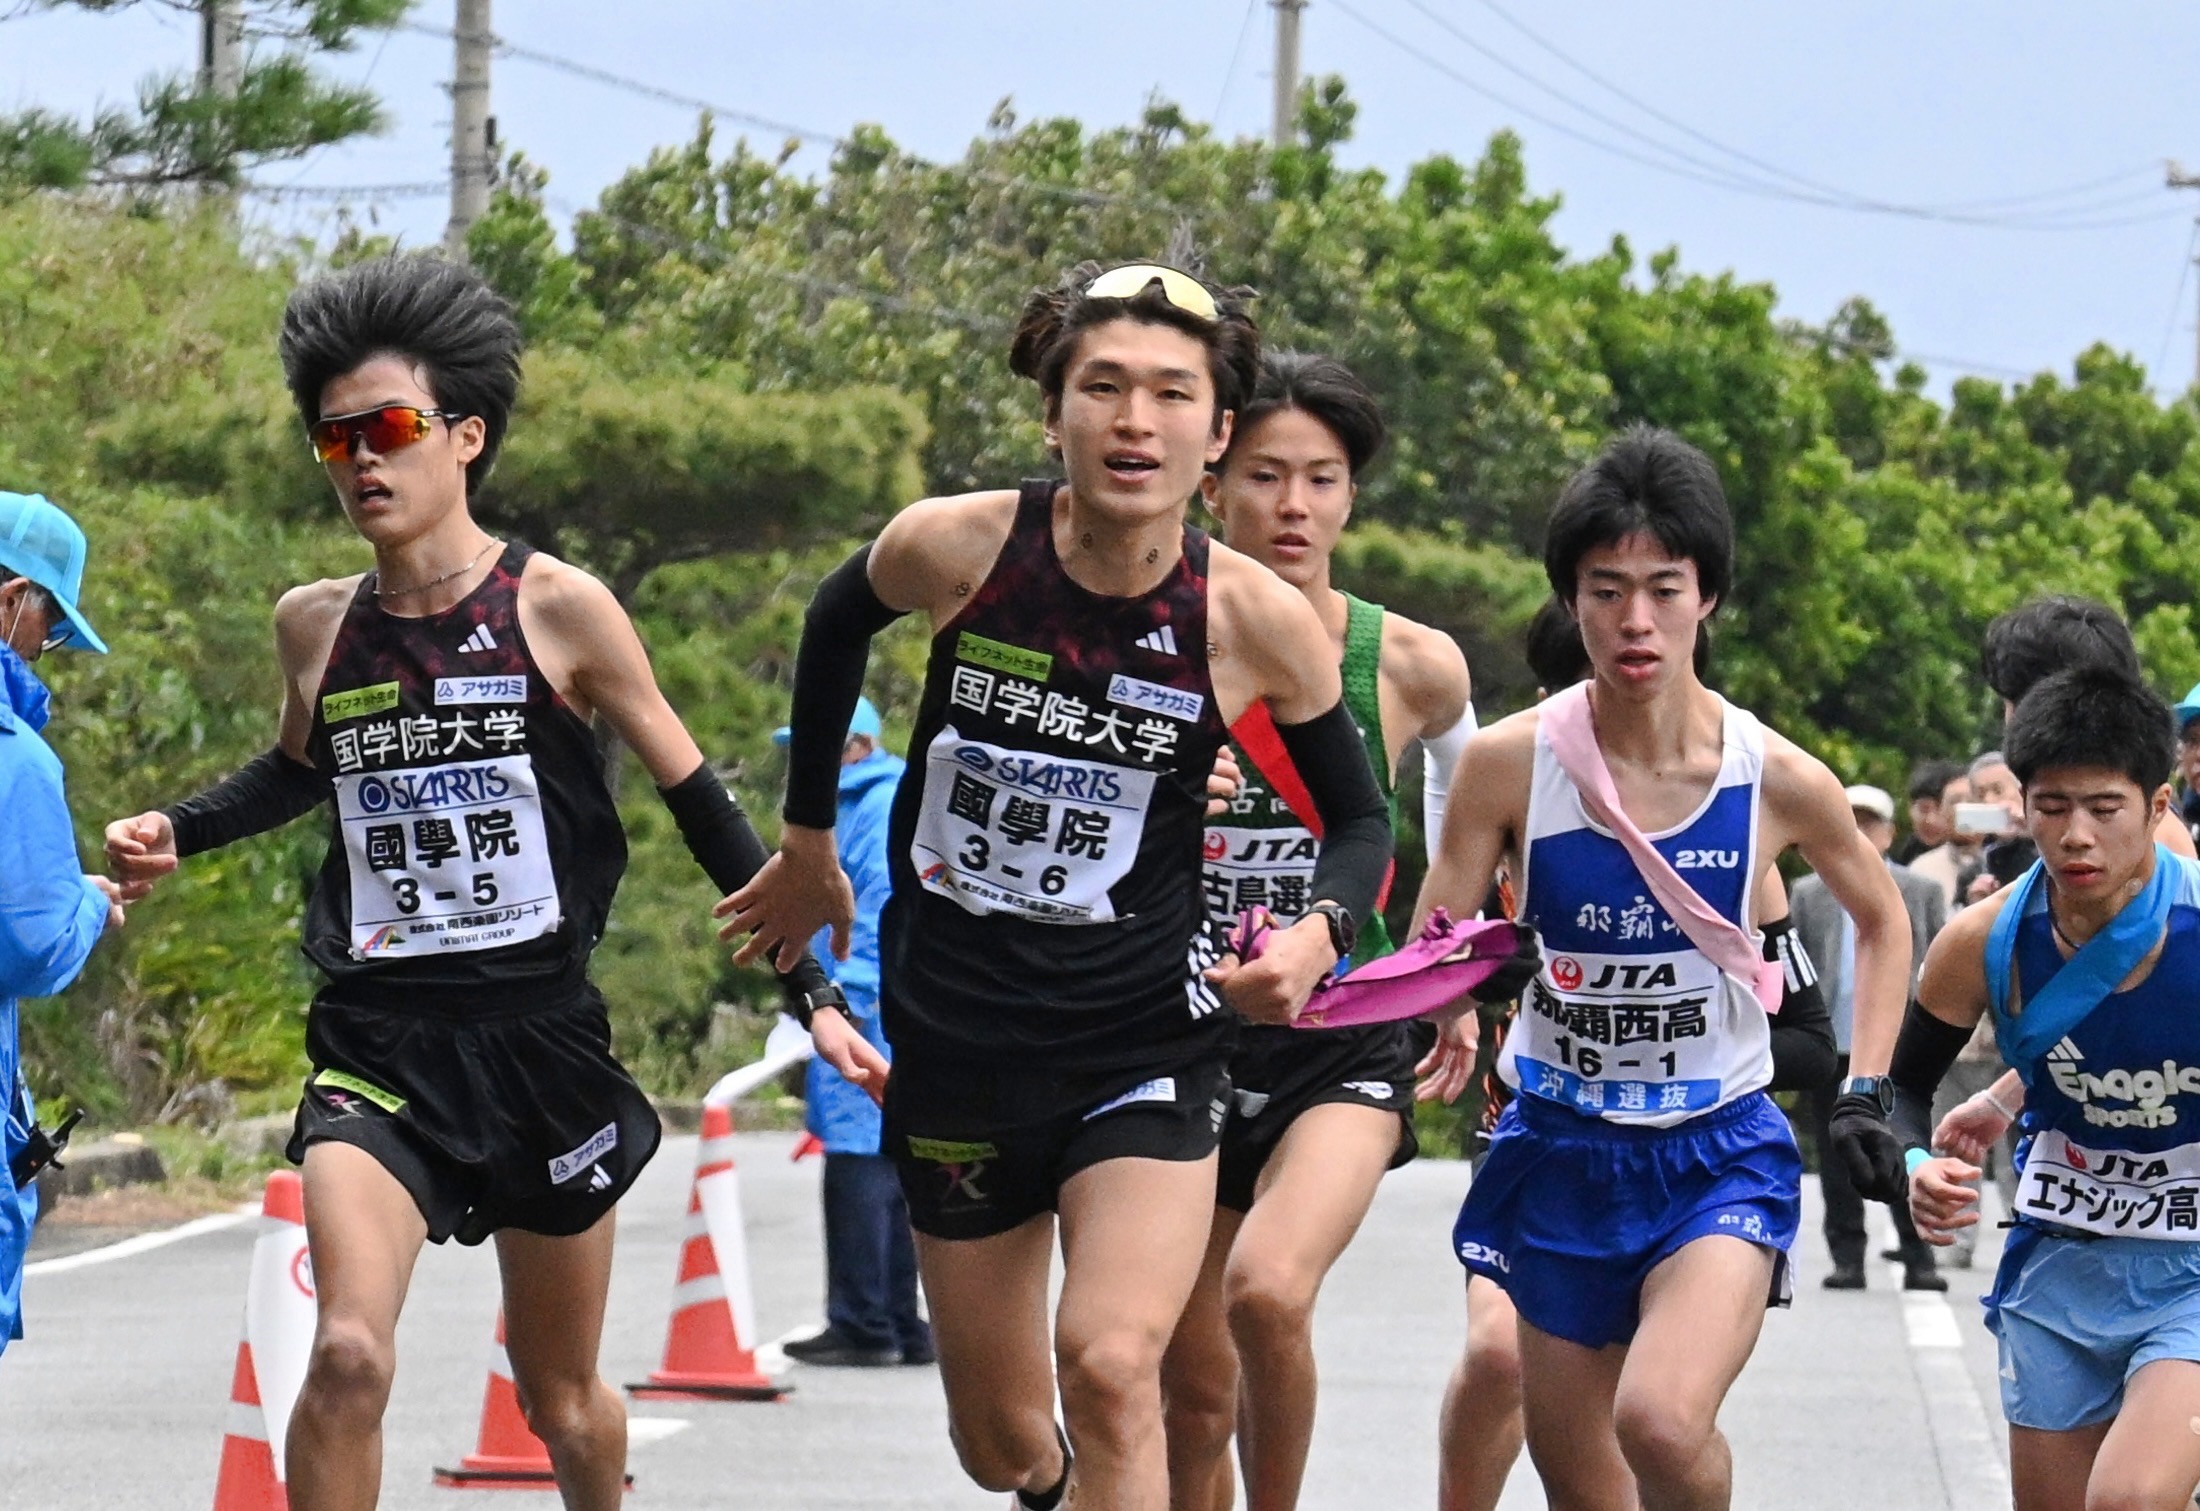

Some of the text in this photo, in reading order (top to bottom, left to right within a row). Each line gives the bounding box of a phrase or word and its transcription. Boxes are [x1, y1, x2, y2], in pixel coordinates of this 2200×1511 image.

[461, 679, 523, 697] アサガミ
[1137, 684, 1200, 716] アサガミ
[950, 665, 1179, 763] 国学院大学
[330, 709, 526, 773] 国学院大学
[946, 769, 1111, 861] 國學院
[365, 809, 520, 873] 國學院
[1231, 837, 1316, 862] JTA
[1675, 850, 1739, 869] 2XU
[1590, 962, 1677, 989] JTA
[1533, 976, 1709, 1047] 那覇西高
[1538, 1066, 1689, 1110] 沖縄選抜
[2047, 1059, 2200, 1112] Enagic
[2093, 1154, 2169, 1182] JTA
[2027, 1171, 2199, 1231] エナジック高
